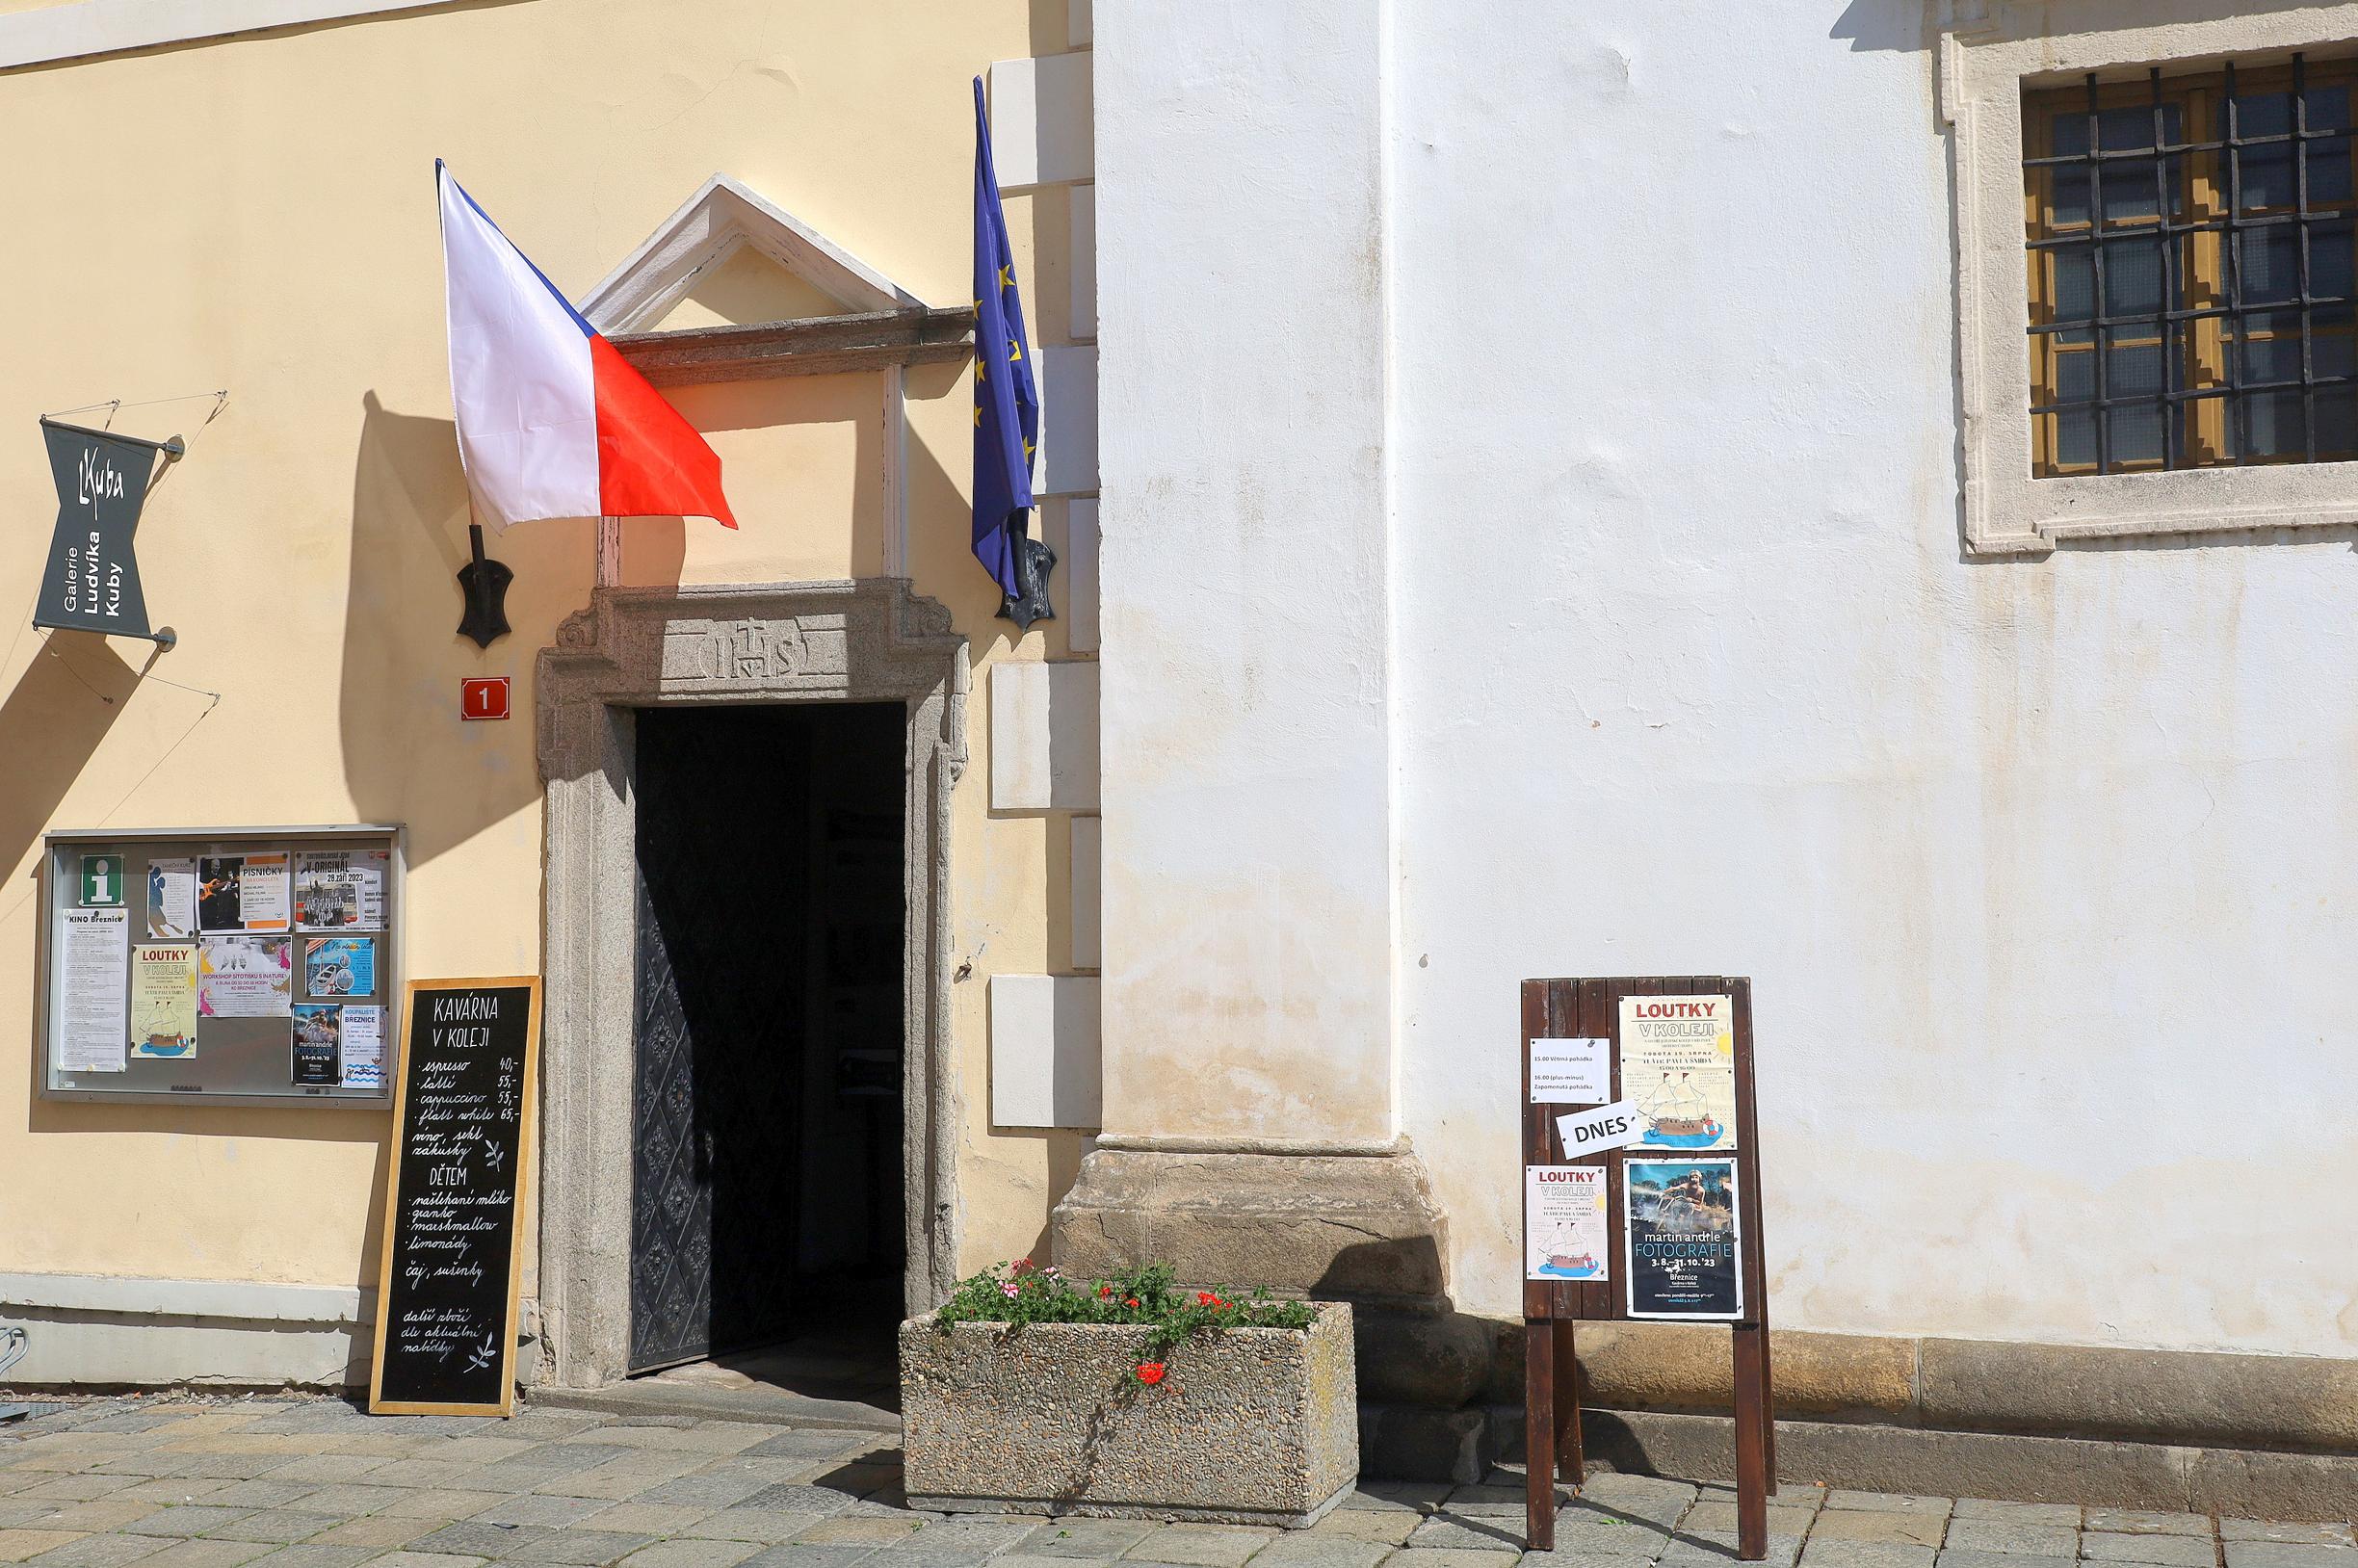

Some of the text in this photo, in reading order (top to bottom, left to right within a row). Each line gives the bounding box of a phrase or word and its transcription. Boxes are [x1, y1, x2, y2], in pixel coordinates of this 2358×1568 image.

[64, 546, 79, 614] Galerie
[84, 531, 100, 614] Ludvíka
[106, 562, 123, 617] Kuby
[479, 687, 488, 710] 1
[348, 873, 363, 882] 2023
[143, 950, 189, 961] LOUTKY
[144, 964, 186, 975] V KOLEJI
[433, 991, 499, 1022] KAVÁRNA
[1636, 1003, 1716, 1018] LOUTKY
[432, 1027, 489, 1048] V KOLEJI
[1638, 1023, 1715, 1037] V KOLEJI
[295, 1047, 337, 1056] FOTOGRAFIE
[422, 1061, 471, 1079] espresso
[420, 1091, 487, 1111] cappuccino
[1574, 1116, 1628, 1143] DNES
[411, 1141, 472, 1166] zákusky
[429, 1163, 468, 1186] DĚTEM
[1538, 1171, 1595, 1183] LOUTKY
[411, 1188, 476, 1206] našlehané
[1540, 1186, 1594, 1197] V KOLEJI
[410, 1215, 499, 1231] marshmallow
[411, 1205, 458, 1223] granko
[1644, 1231, 1682, 1242] martin
[406, 1234, 472, 1259] limonády
[1635, 1243, 1732, 1257] FOTOGRAFIE
[432, 1260, 485, 1287] sušenky
[403, 1307, 472, 1322] další zboží
[401, 1322, 483, 1338] dle aktuální
